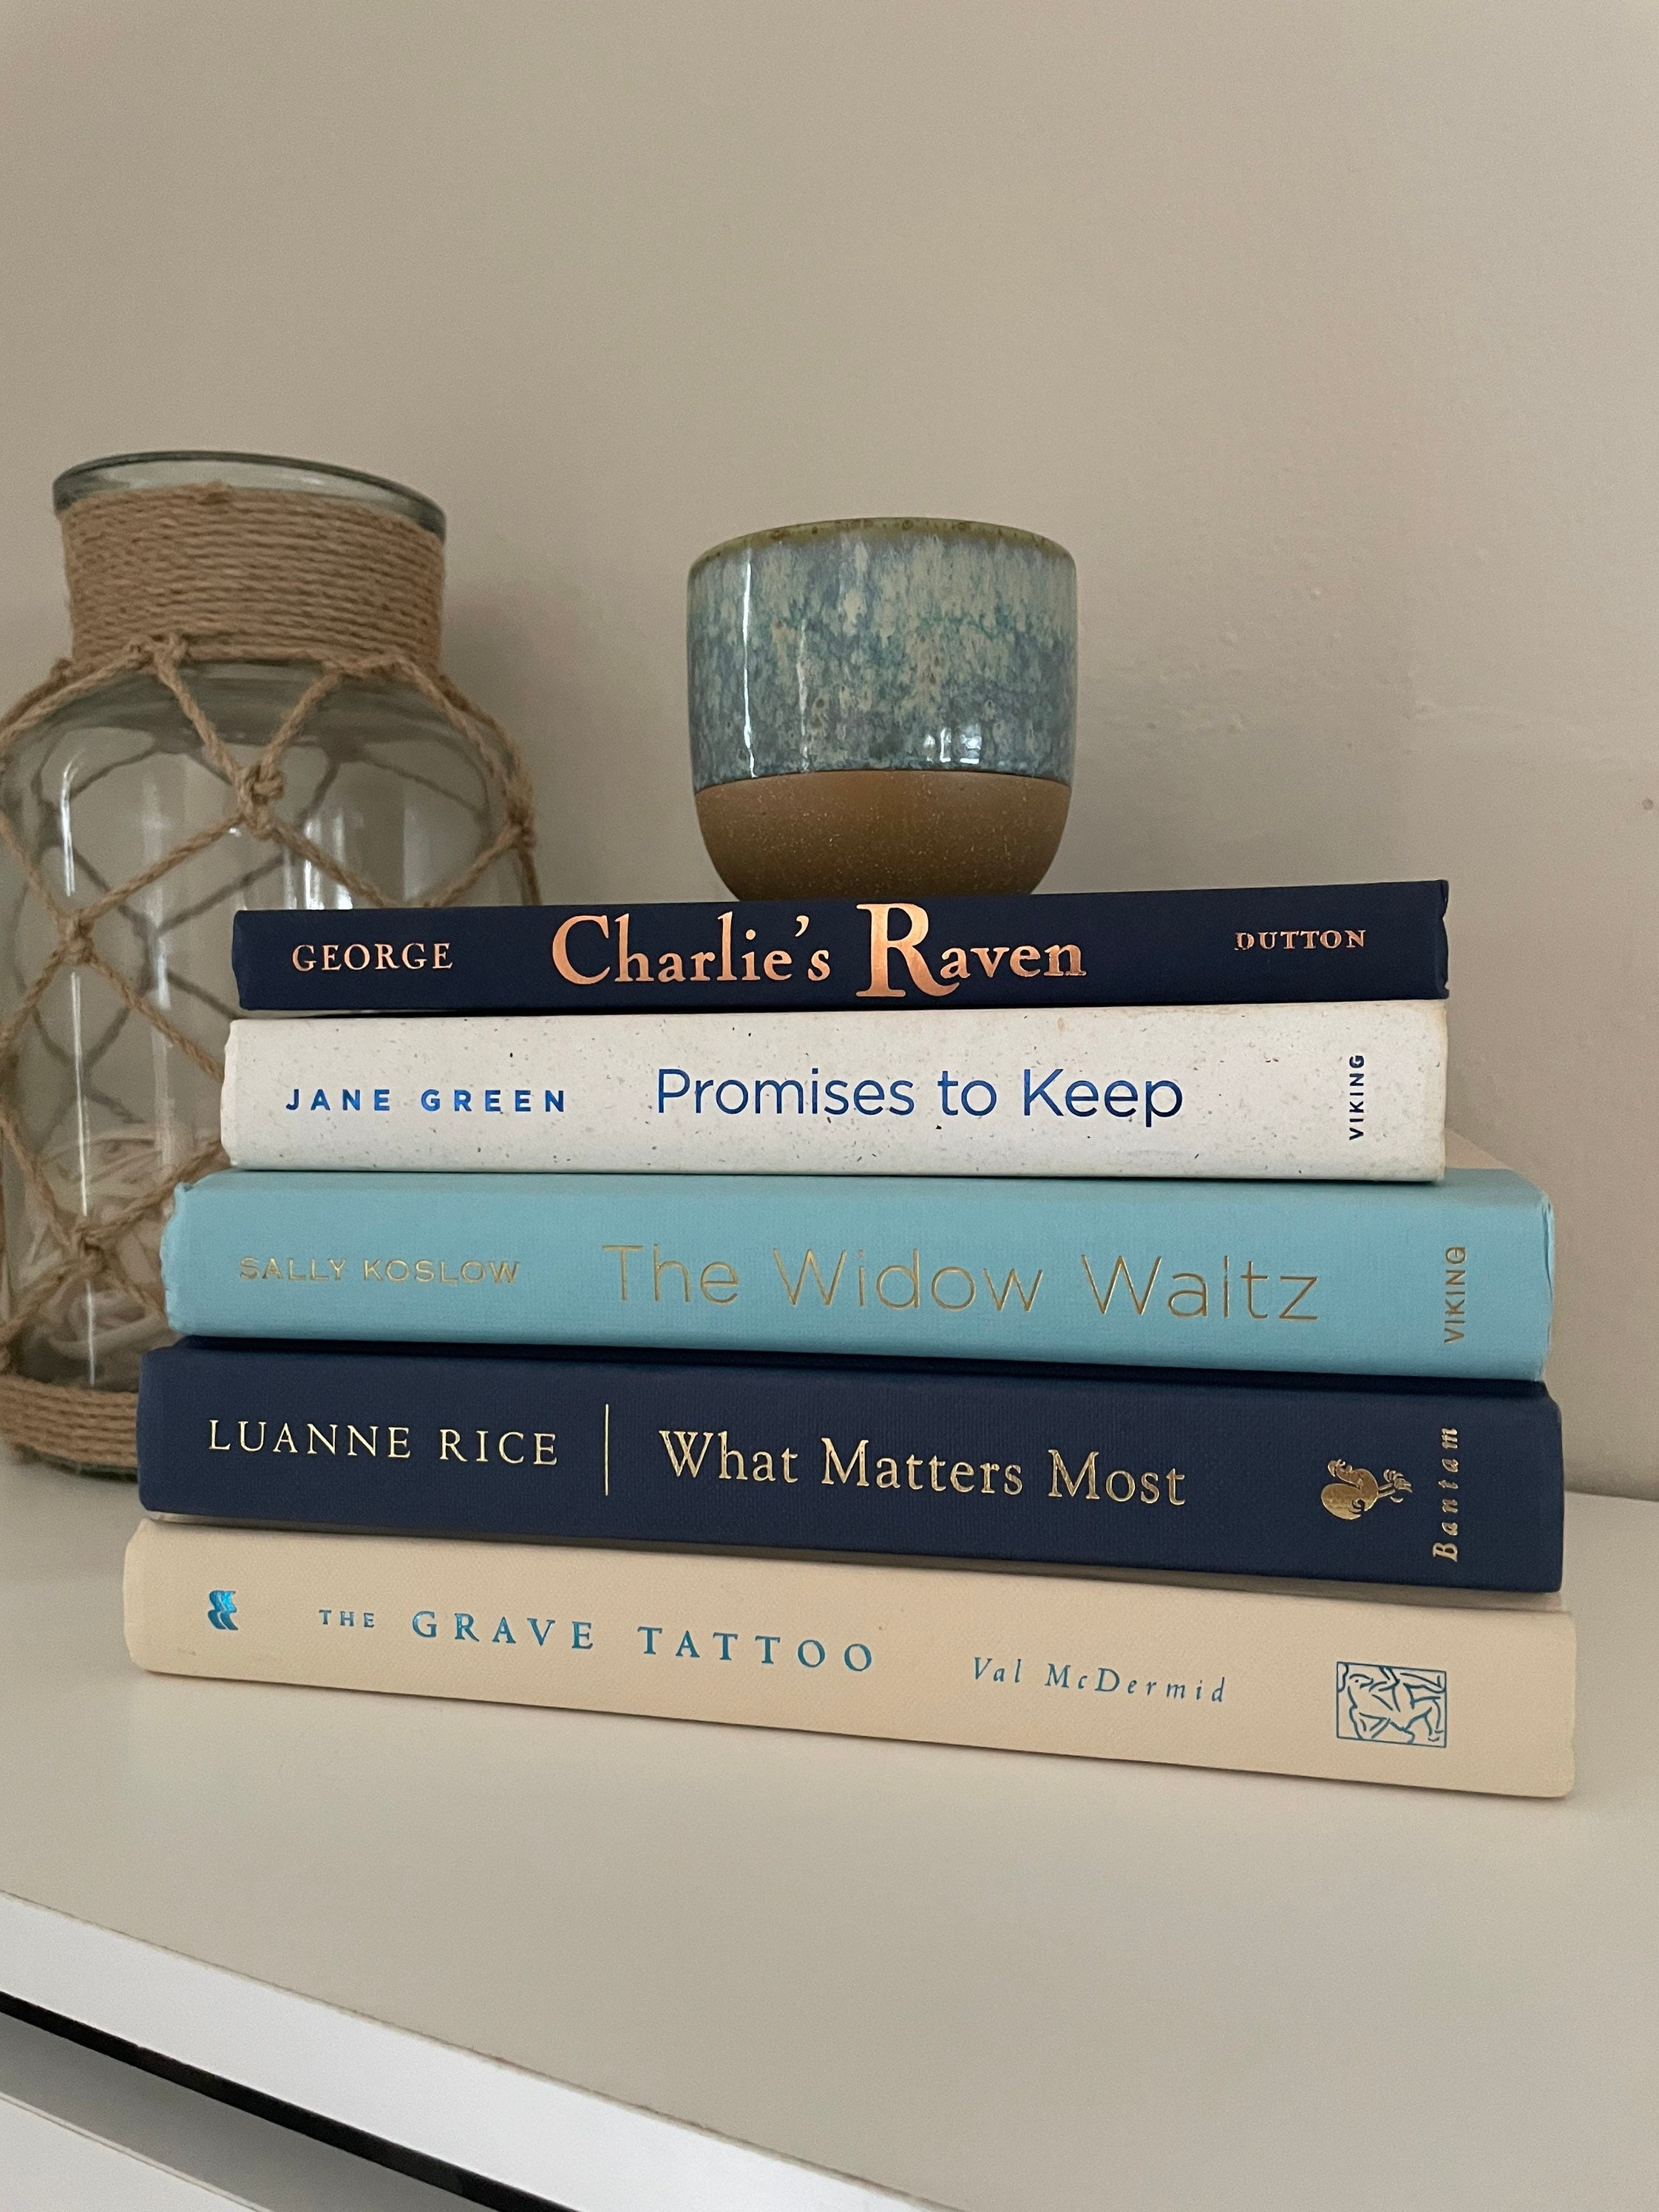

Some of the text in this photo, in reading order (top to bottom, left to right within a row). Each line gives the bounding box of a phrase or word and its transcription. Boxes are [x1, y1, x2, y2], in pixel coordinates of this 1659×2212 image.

[292, 941, 453, 972] GEORGE
[552, 903, 1086, 997] Charlie's Raven
[1235, 929, 1366, 951] DUTTON
[286, 1089, 566, 1113] JANE GREEN
[658, 1068, 1184, 1127] Promises to Keep
[1348, 1054, 1365, 1140] VIKING
[240, 1258, 520, 1286] SALLY KOSLOW
[603, 1244, 1319, 1321] The Widow Waltz
[1445, 1246, 1467, 1343] VIKING
[209, 1419, 558, 1466] LUANNE RICE
[659, 1429, 1186, 1505] What Matters Most
[1432, 1426, 1459, 1561] Bantam
[319, 1609, 872, 1672] THE GRAVE TATTOO
[973, 1657, 1226, 1703] Val McDermid
